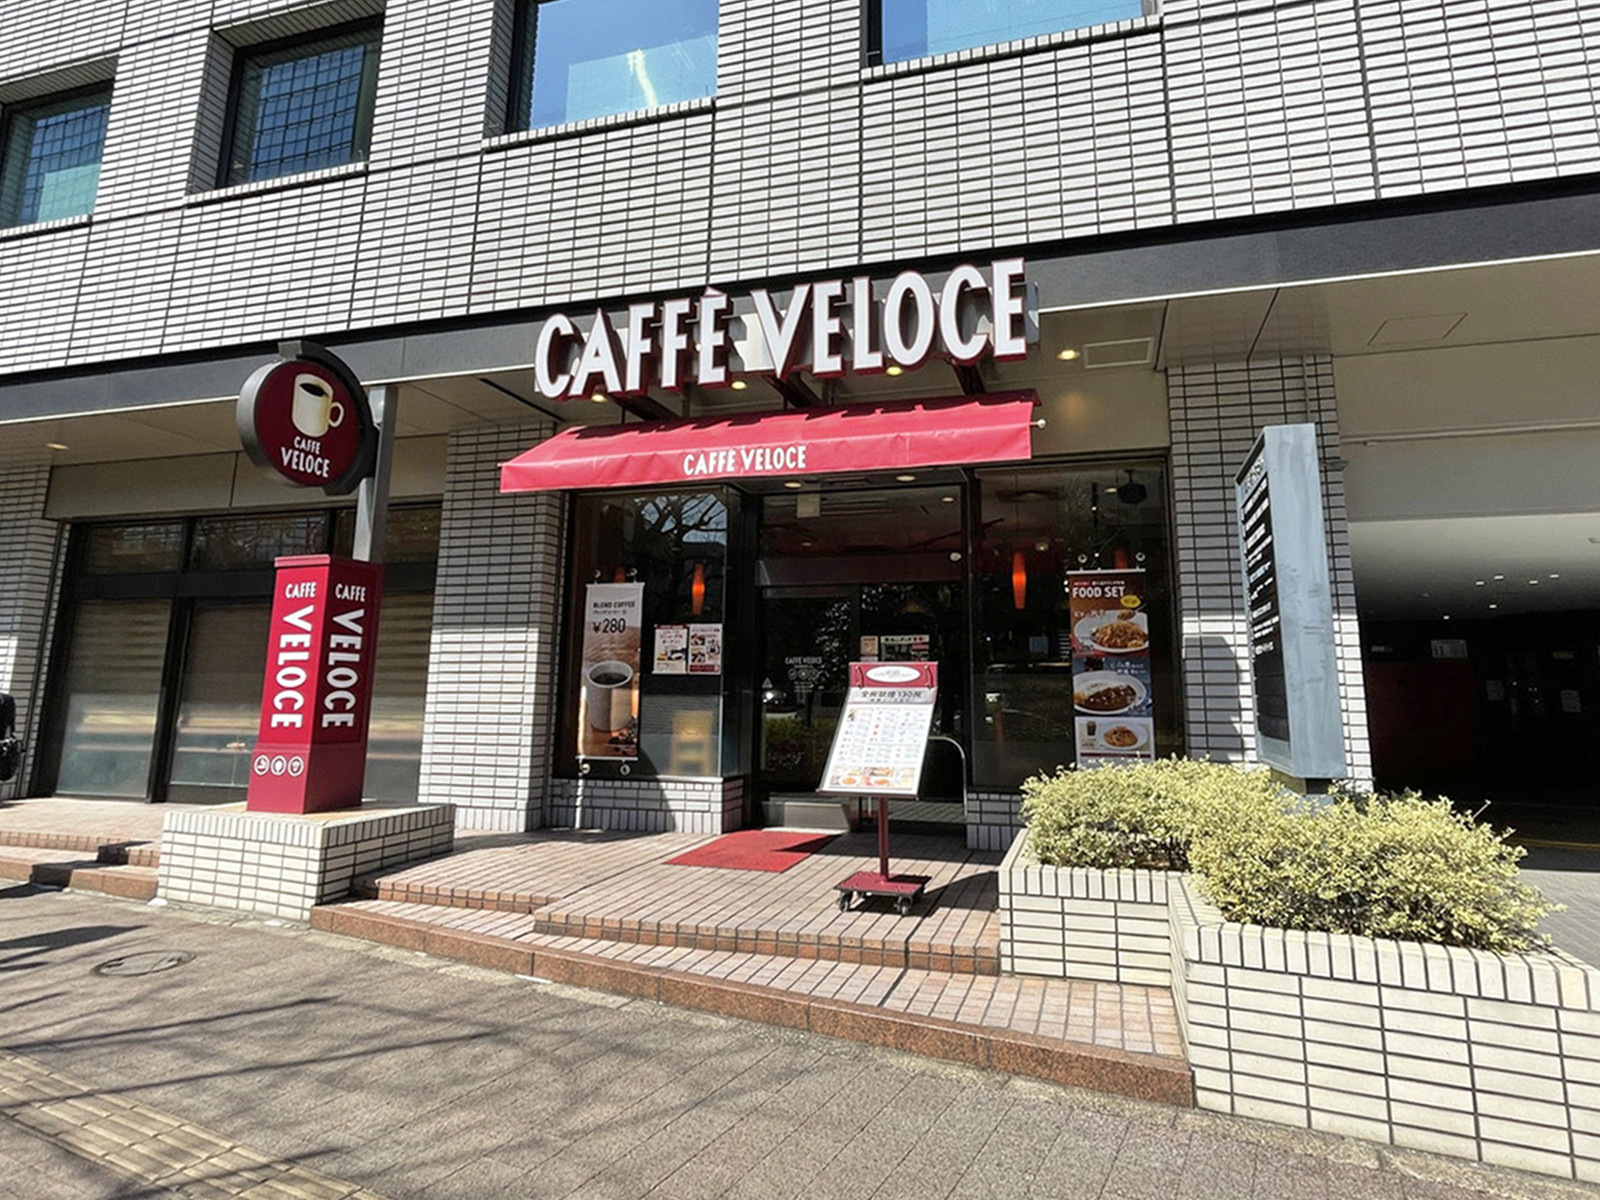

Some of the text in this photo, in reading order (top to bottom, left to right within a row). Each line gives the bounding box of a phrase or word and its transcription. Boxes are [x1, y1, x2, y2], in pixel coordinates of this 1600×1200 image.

[534, 258, 1027, 399] CAFFÈ VELOCE
[281, 446, 330, 478] VELOCE
[740, 446, 807, 471] VELOCE
[1072, 586, 1126, 599] FOOD SET
[592, 617, 626, 634] ¥280
[271, 604, 314, 728] VELOCE
[322, 608, 365, 728] VELOCE
